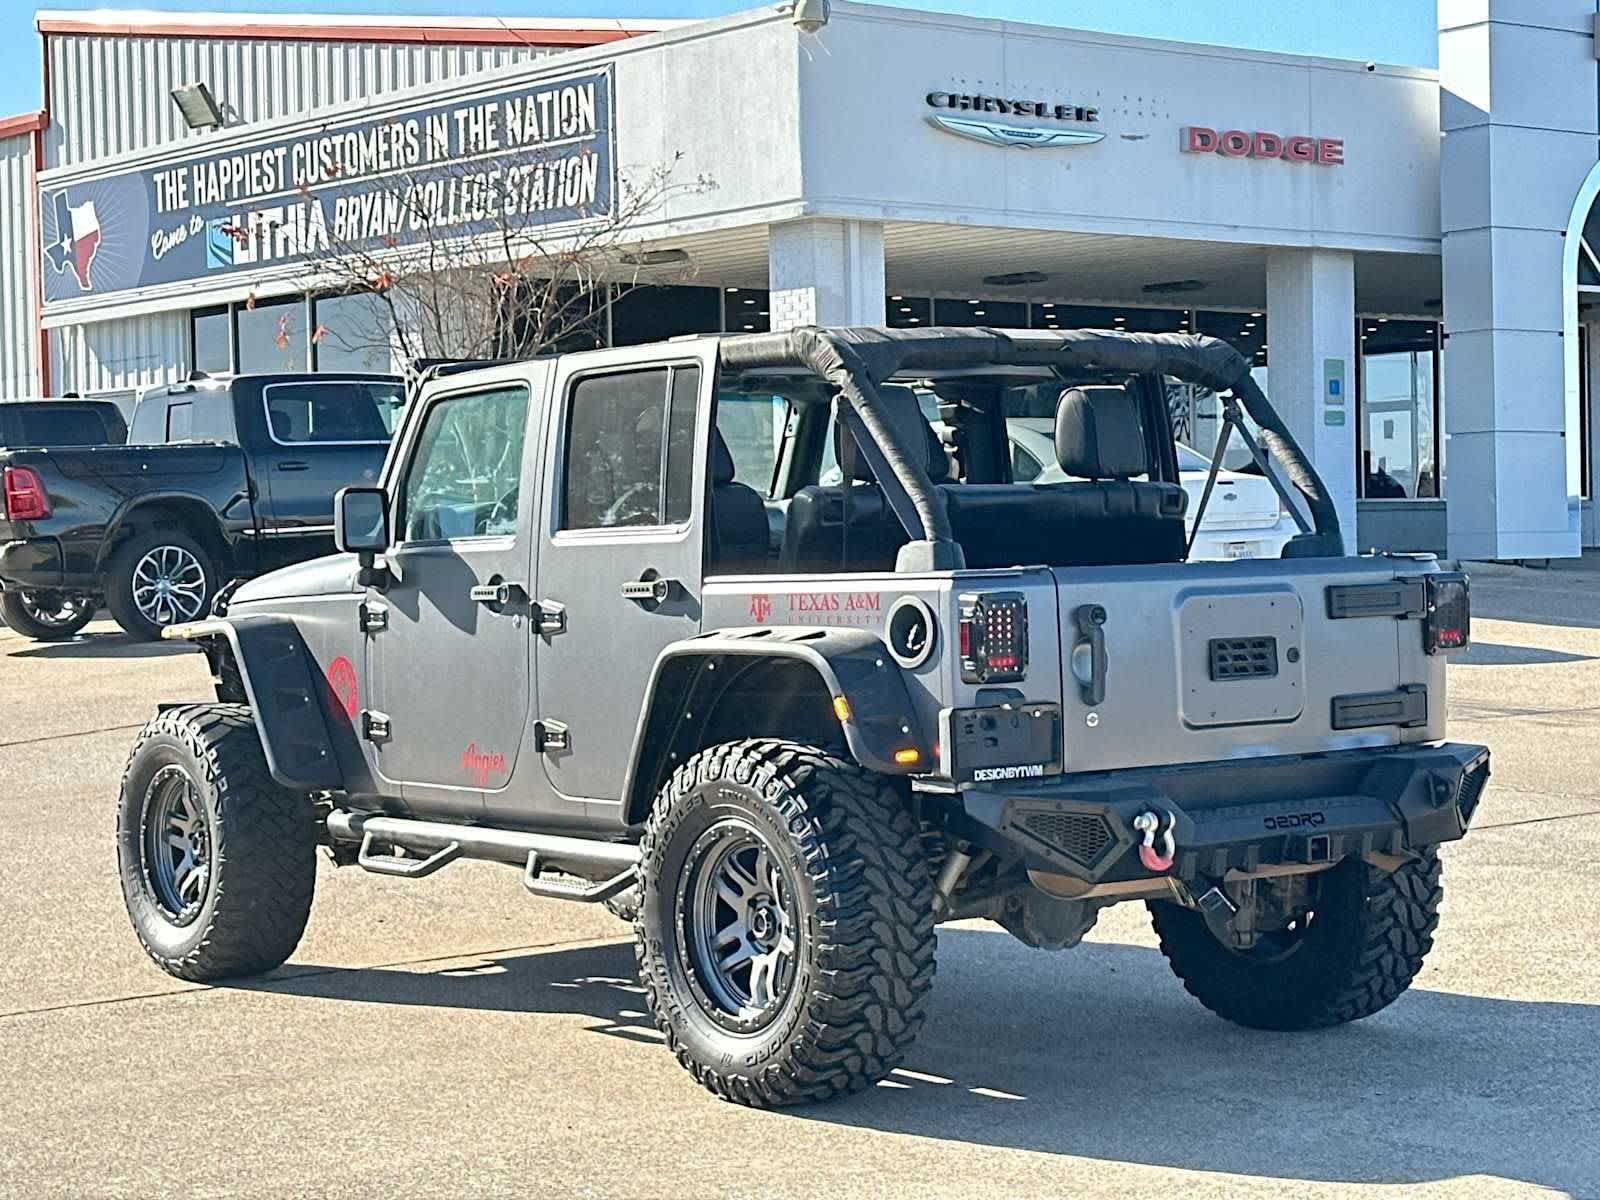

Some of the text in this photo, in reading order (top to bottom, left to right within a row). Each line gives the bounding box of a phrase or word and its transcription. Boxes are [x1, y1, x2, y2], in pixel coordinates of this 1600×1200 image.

[926, 91, 1100, 122] CHRYSLER
[153, 83, 596, 213] THE HAPPIEST CUSTOMERS IN THE NATION
[1180, 126, 1345, 165] DODGE
[152, 224, 188, 260] Come
[185, 214, 205, 234] to
[232, 200, 331, 265] LITHIA
[503, 153, 600, 216] STATION
[786, 591, 881, 612] TEXAS A&M
[787, 614, 881, 625] UNIVERSITY
[974, 764, 1044, 782] DESIGNBYTWM
